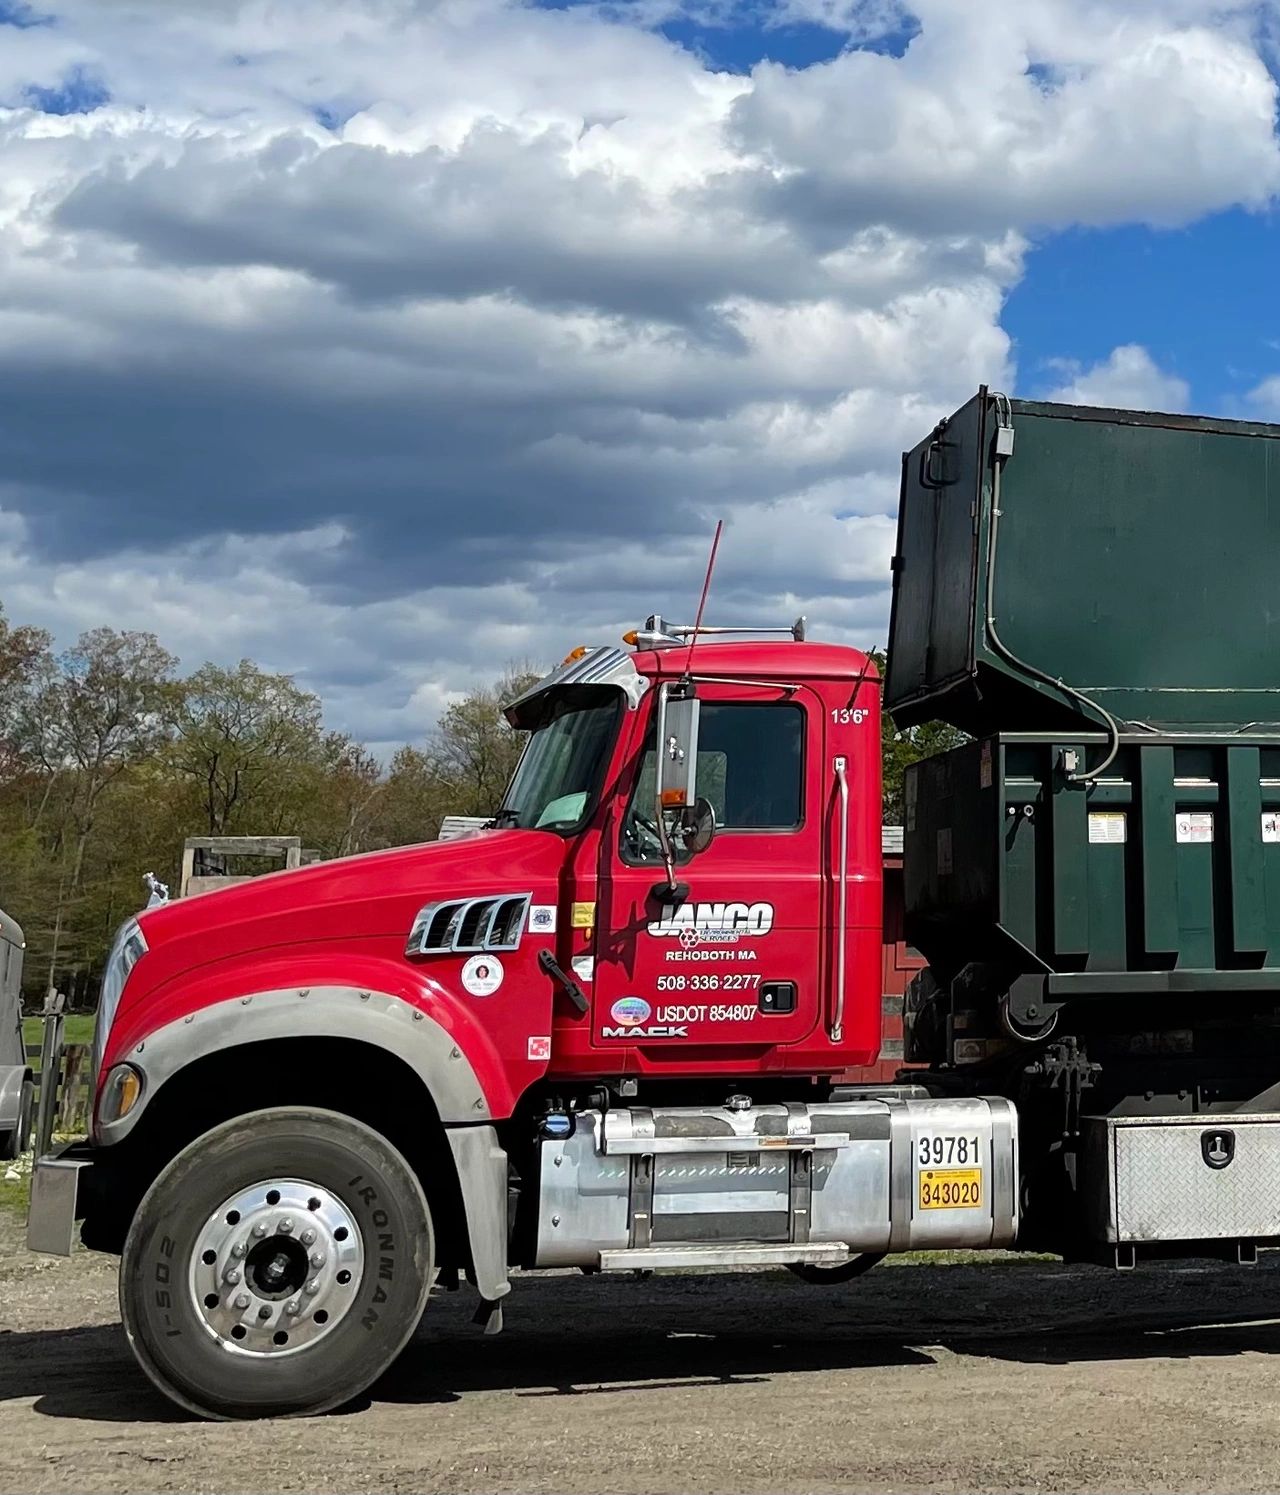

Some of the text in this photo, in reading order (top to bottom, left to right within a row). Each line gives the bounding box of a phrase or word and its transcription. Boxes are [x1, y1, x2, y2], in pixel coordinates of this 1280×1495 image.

[831, 708, 869, 724] 13'6"
[647, 902, 774, 936] JANCO
[665, 951, 757, 961] REHOBOTH MA
[656, 1005, 707, 1022] USDOT
[709, 1005, 758, 1021] 854807
[602, 1026, 688, 1037] MACK
[919, 1136, 979, 1164] 39781
[922, 1182, 979, 1205] 343020
[348, 1175, 395, 1331] IRONMAN
